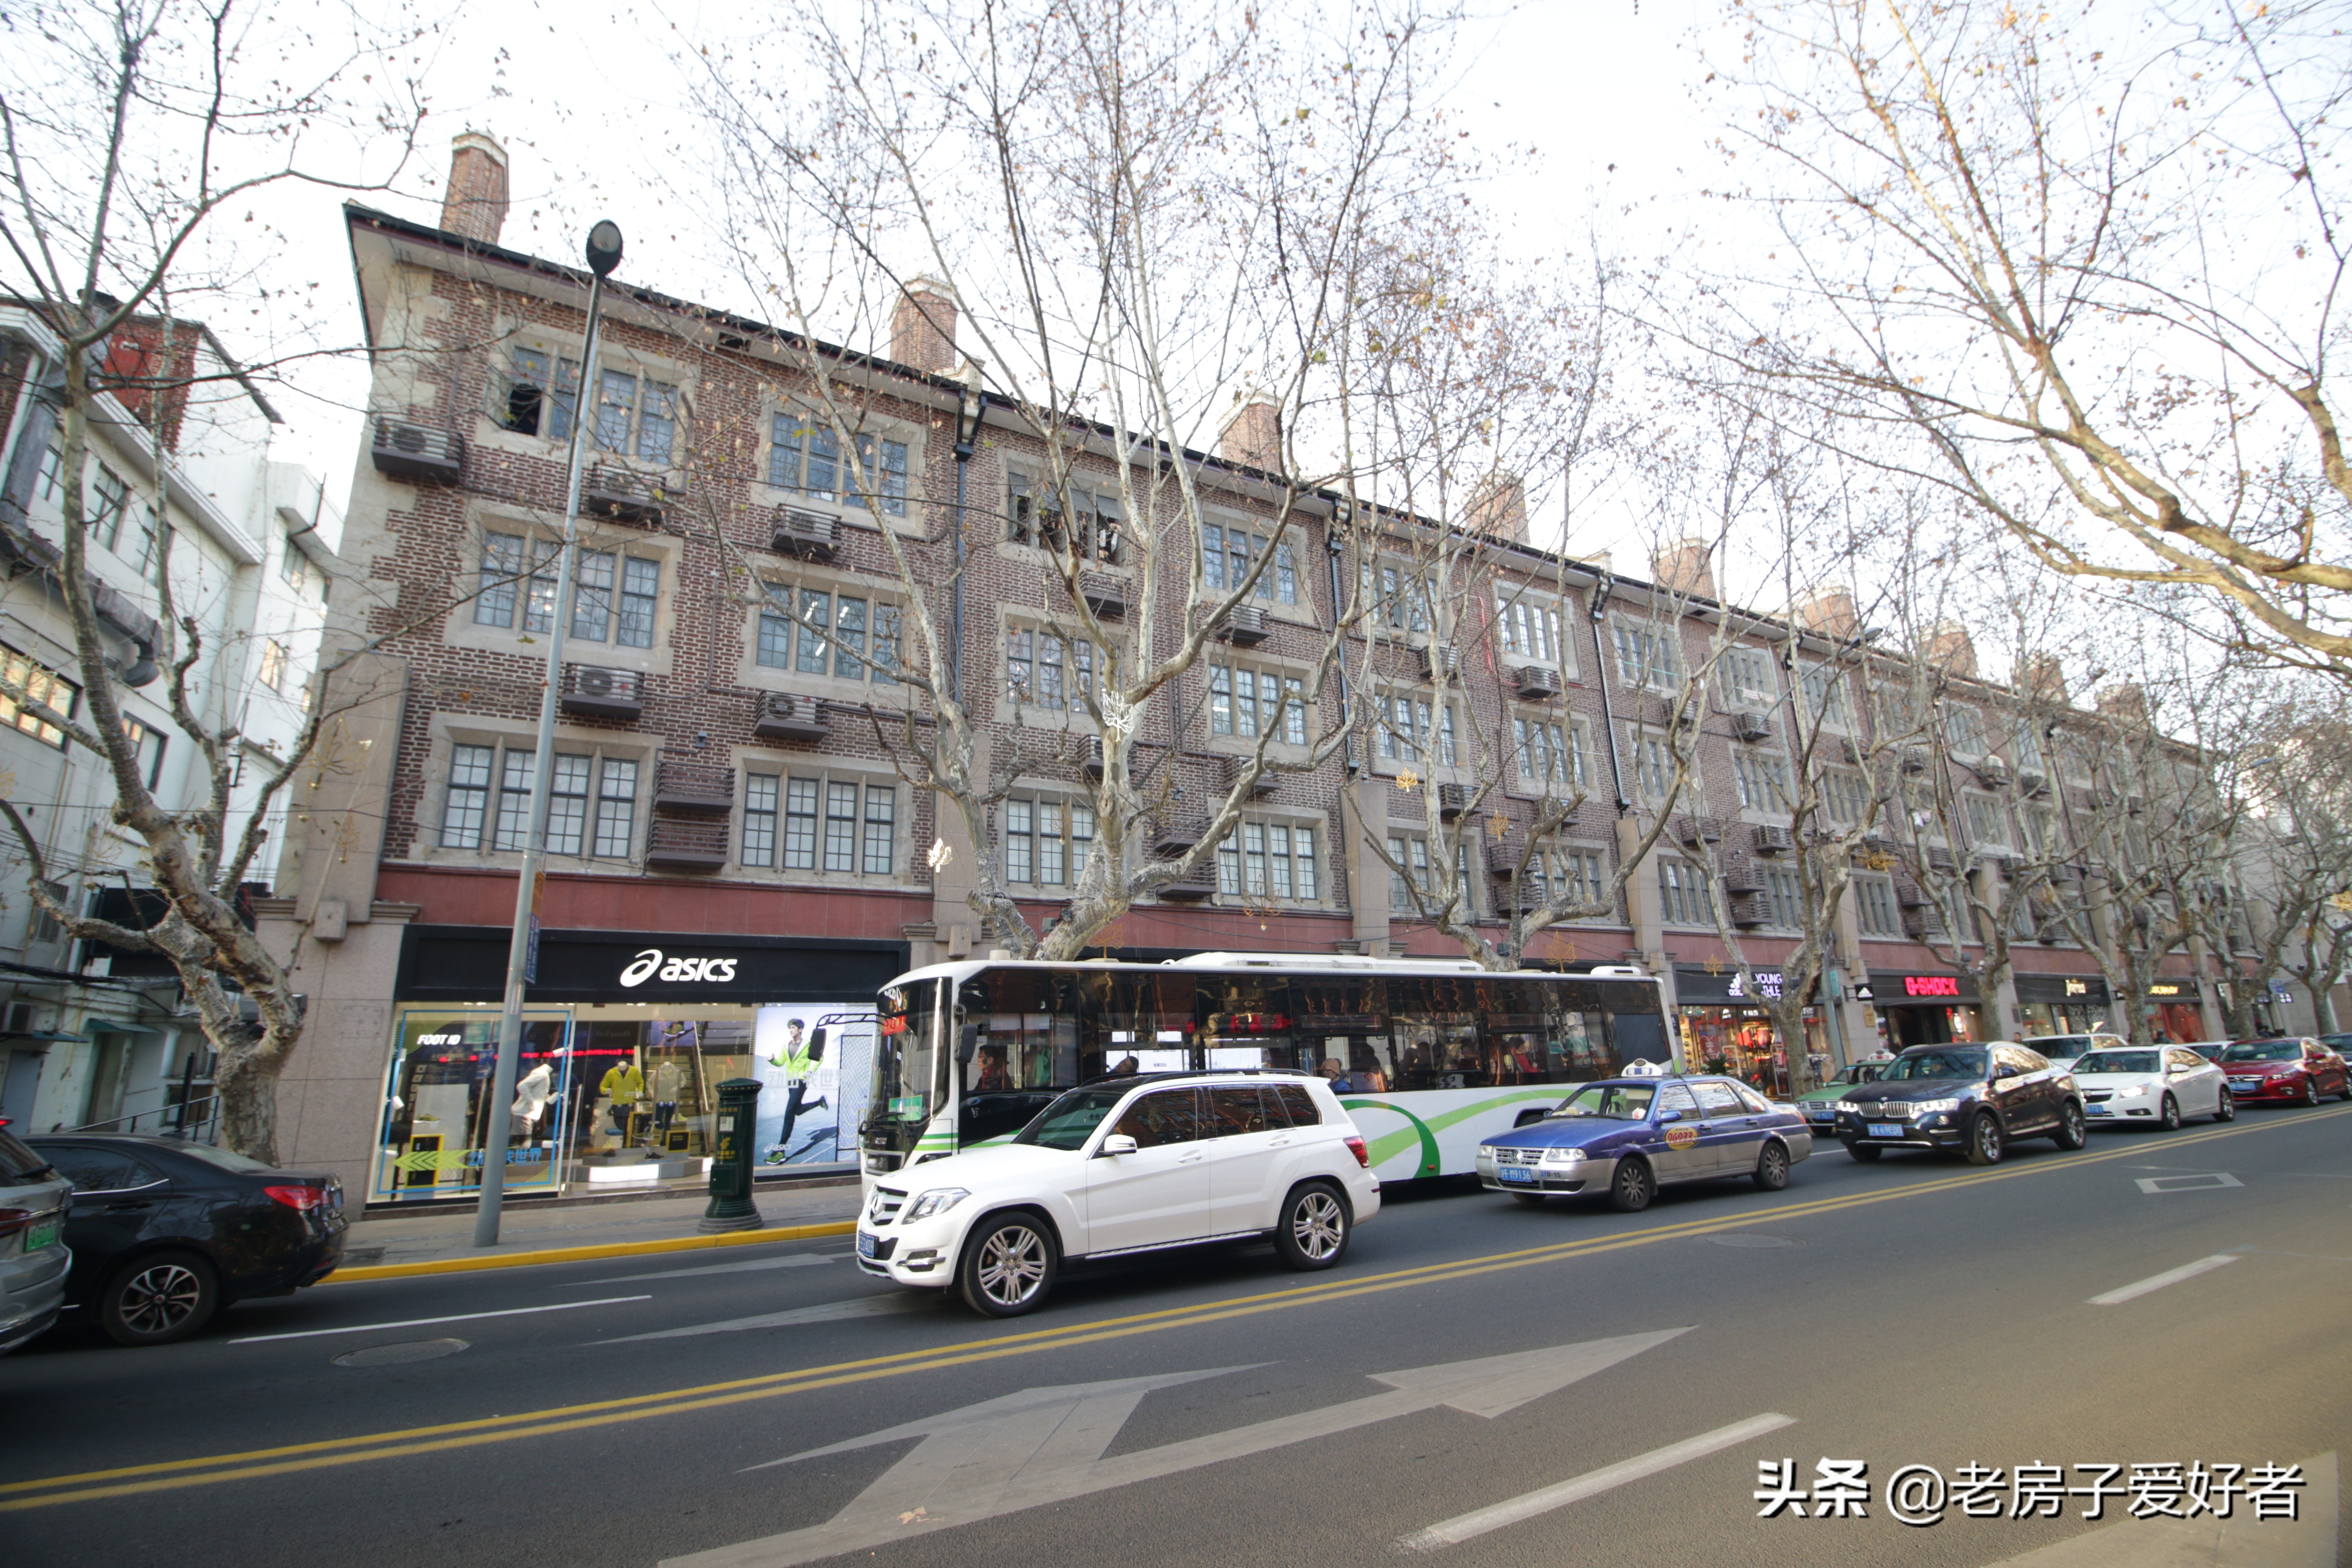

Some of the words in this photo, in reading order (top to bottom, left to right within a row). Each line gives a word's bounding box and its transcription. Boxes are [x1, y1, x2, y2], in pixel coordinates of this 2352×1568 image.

[660, 958, 738, 982] asics
[1755, 974, 1782, 985] YOUNG
[1905, 976, 1960, 996] G-SHOCK
[416, 1034, 448, 1045] FOOT
[447, 1034, 461, 1045] ID
